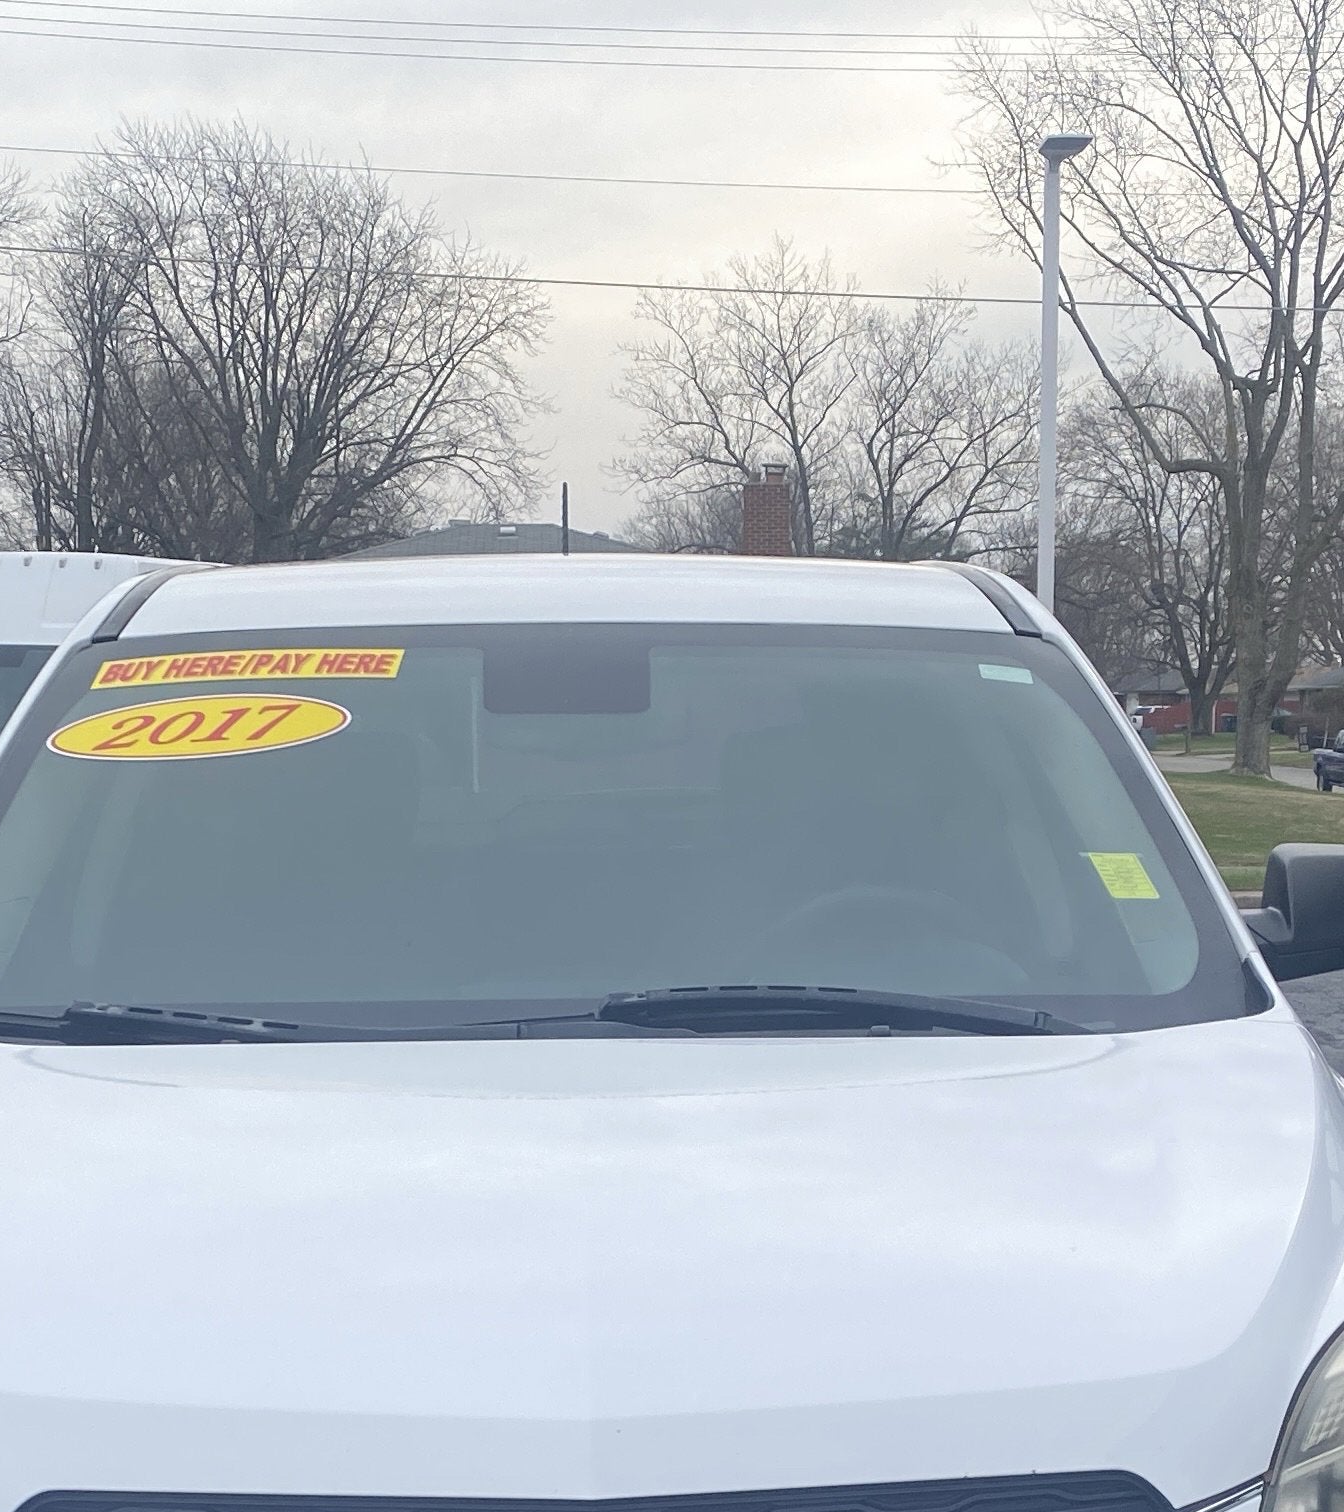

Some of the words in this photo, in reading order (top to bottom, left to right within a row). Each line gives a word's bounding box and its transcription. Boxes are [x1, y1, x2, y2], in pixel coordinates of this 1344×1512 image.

[99, 660, 165, 684] BUY
[315, 653, 397, 674] HERE
[91, 703, 302, 752] 2017
